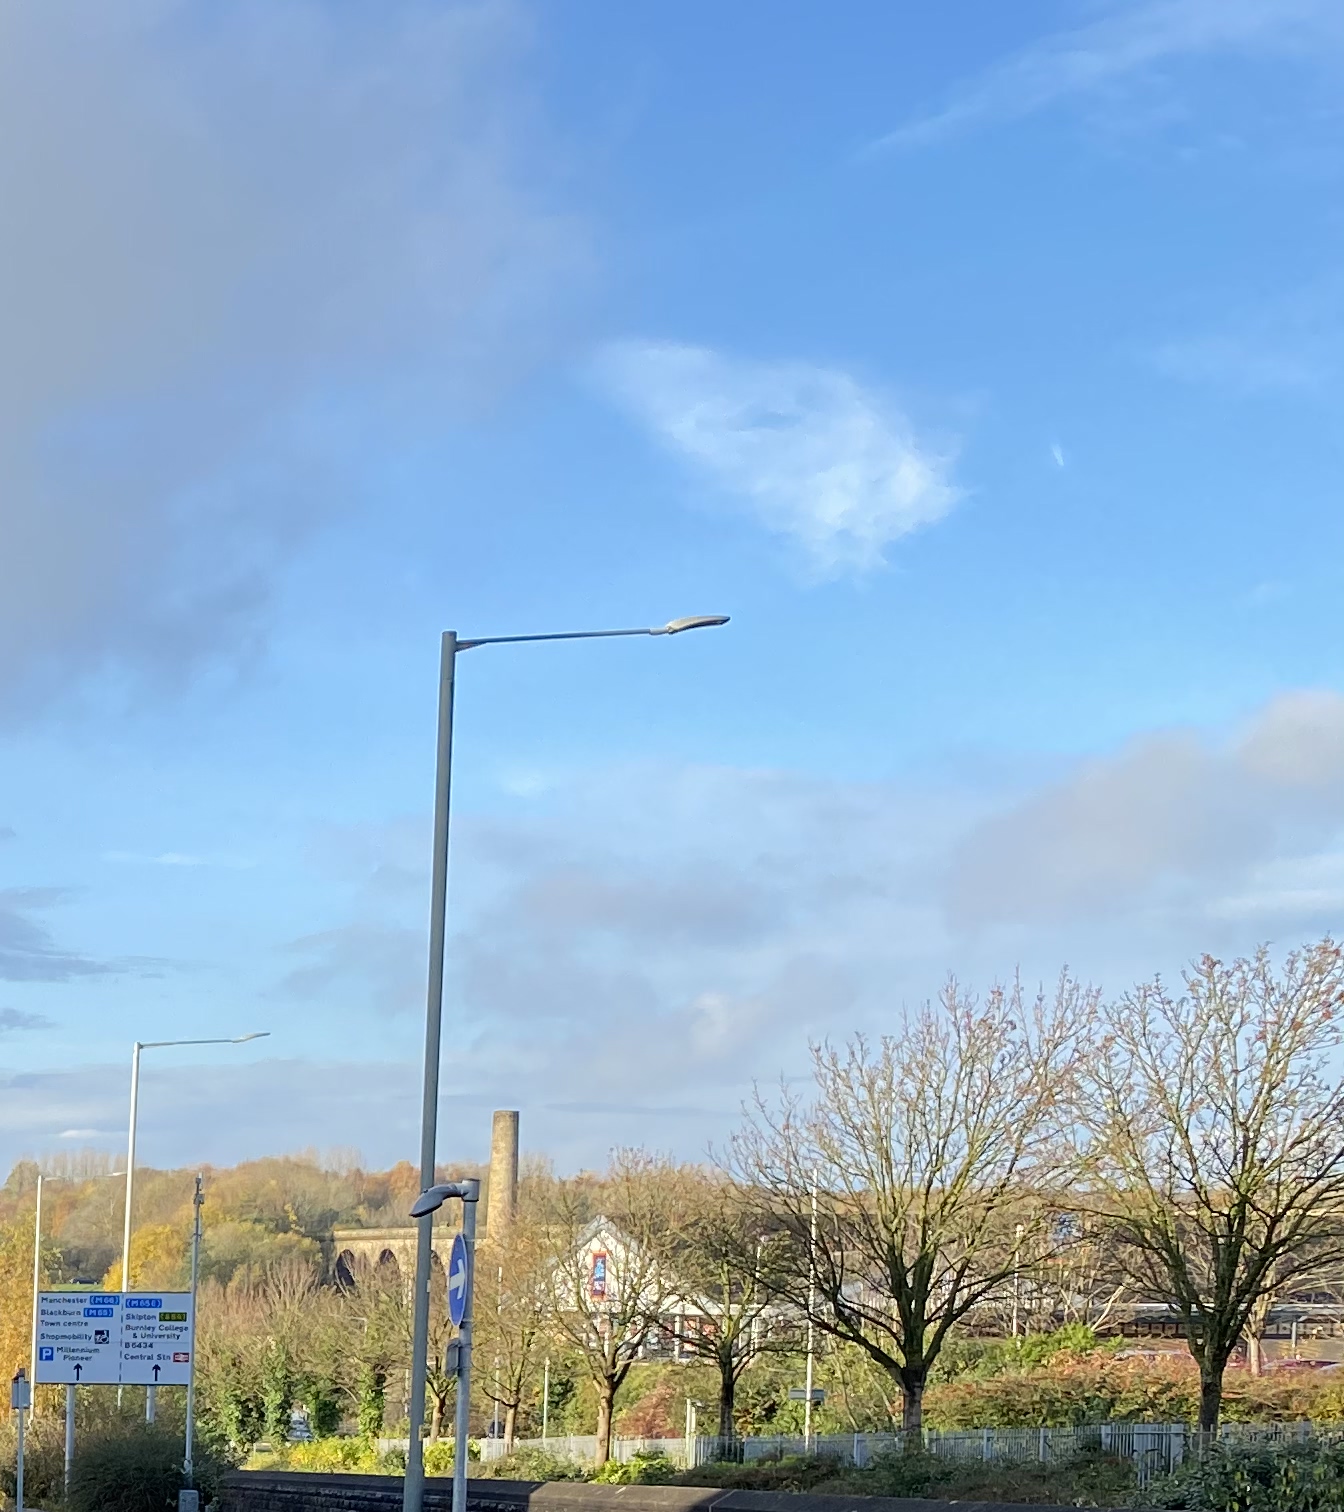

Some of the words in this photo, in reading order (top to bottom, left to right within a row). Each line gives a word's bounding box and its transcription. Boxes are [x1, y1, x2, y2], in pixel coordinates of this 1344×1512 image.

[126, 1313, 156, 1321] Skipton
[125, 1324, 155, 1332] Burnley
[158, 1324, 188, 1332] College
[40, 1332, 92, 1341] Shopmobility
[141, 1332, 180, 1340] University
